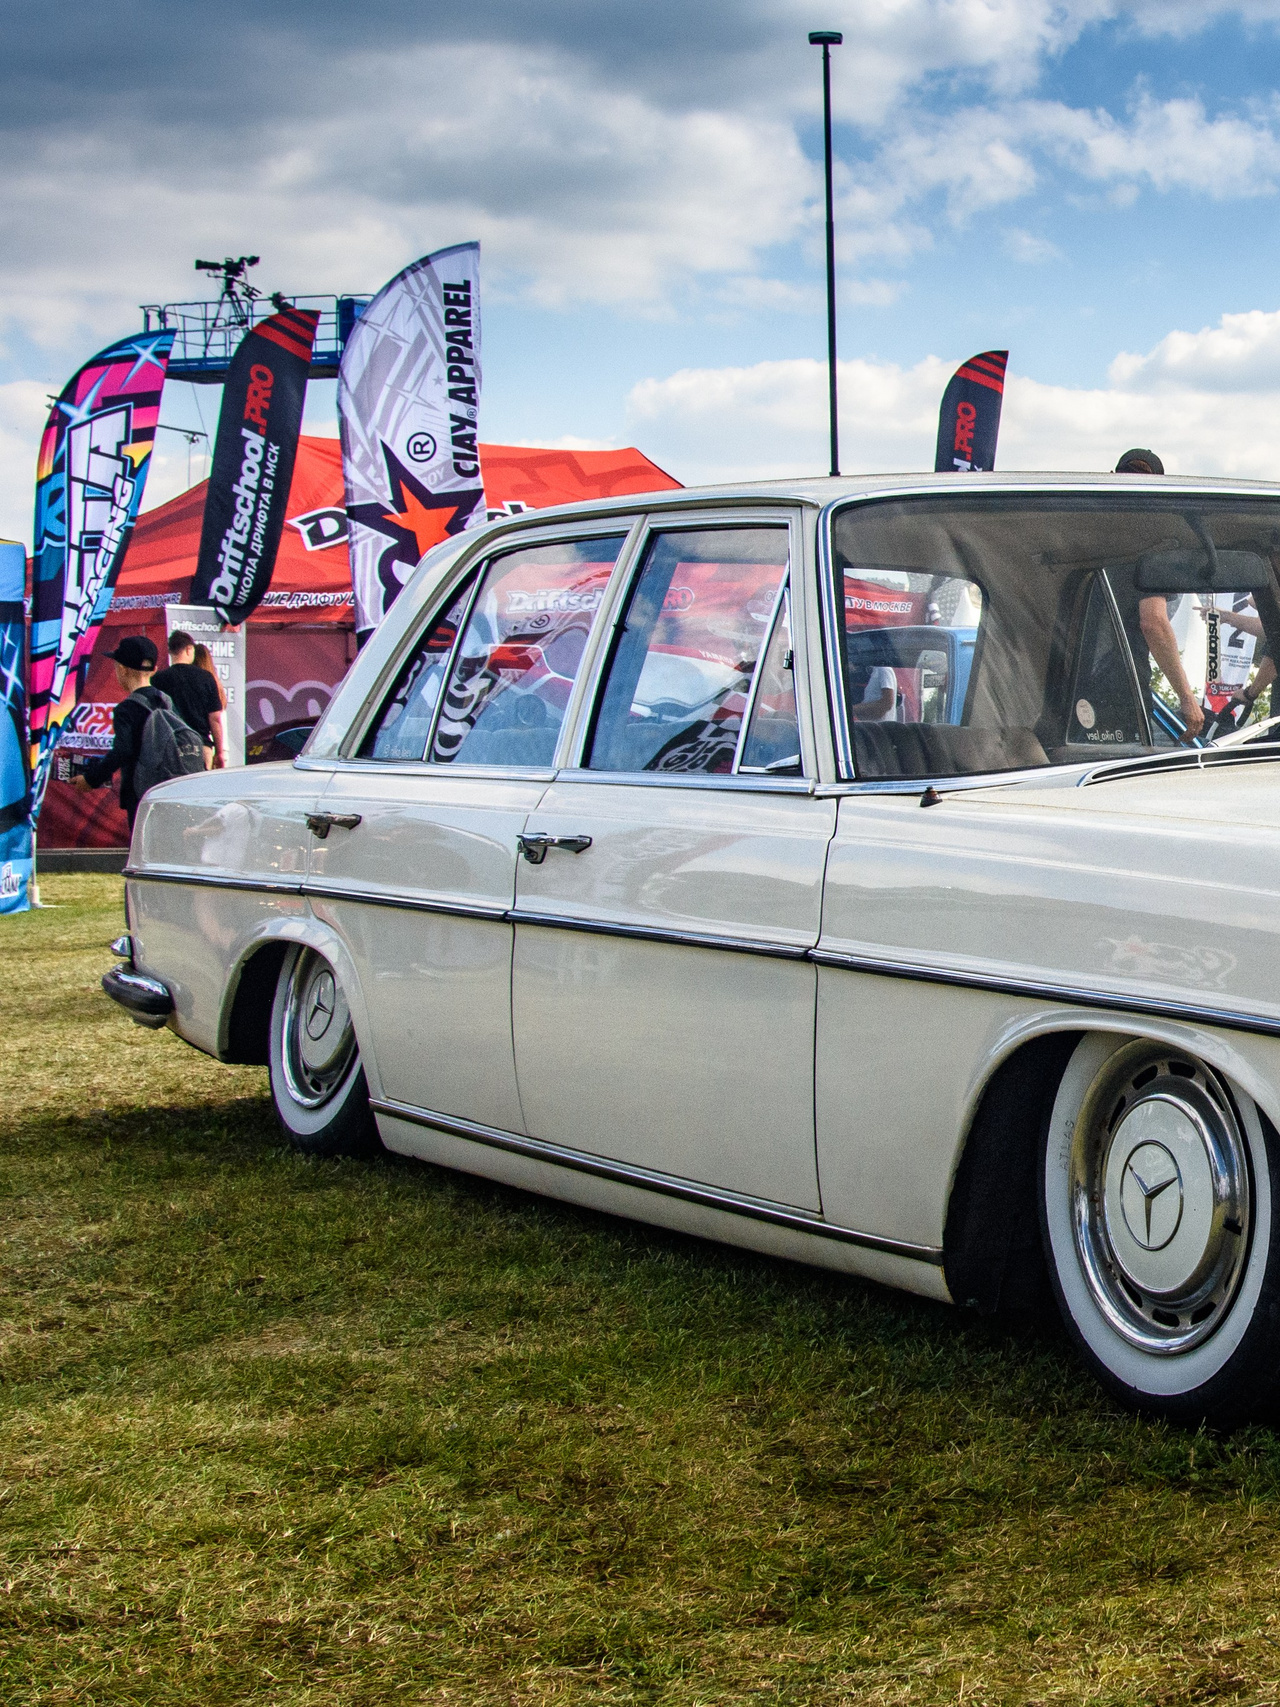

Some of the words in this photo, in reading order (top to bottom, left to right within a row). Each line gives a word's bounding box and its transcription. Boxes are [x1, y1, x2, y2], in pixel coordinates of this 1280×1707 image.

[442, 279, 478, 408] APPAREL
[267, 441, 281, 477] МСК
[263, 476, 275, 488] В
[250, 492, 273, 558] ДРИФТА
[75, 473, 134, 635] RACING
[233, 557, 260, 607] ШКОЛА
[288, 591, 348, 609] ДРИФТУ
[865, 600, 872, 609] В
[873, 601, 913, 613] МОСКВЕ
